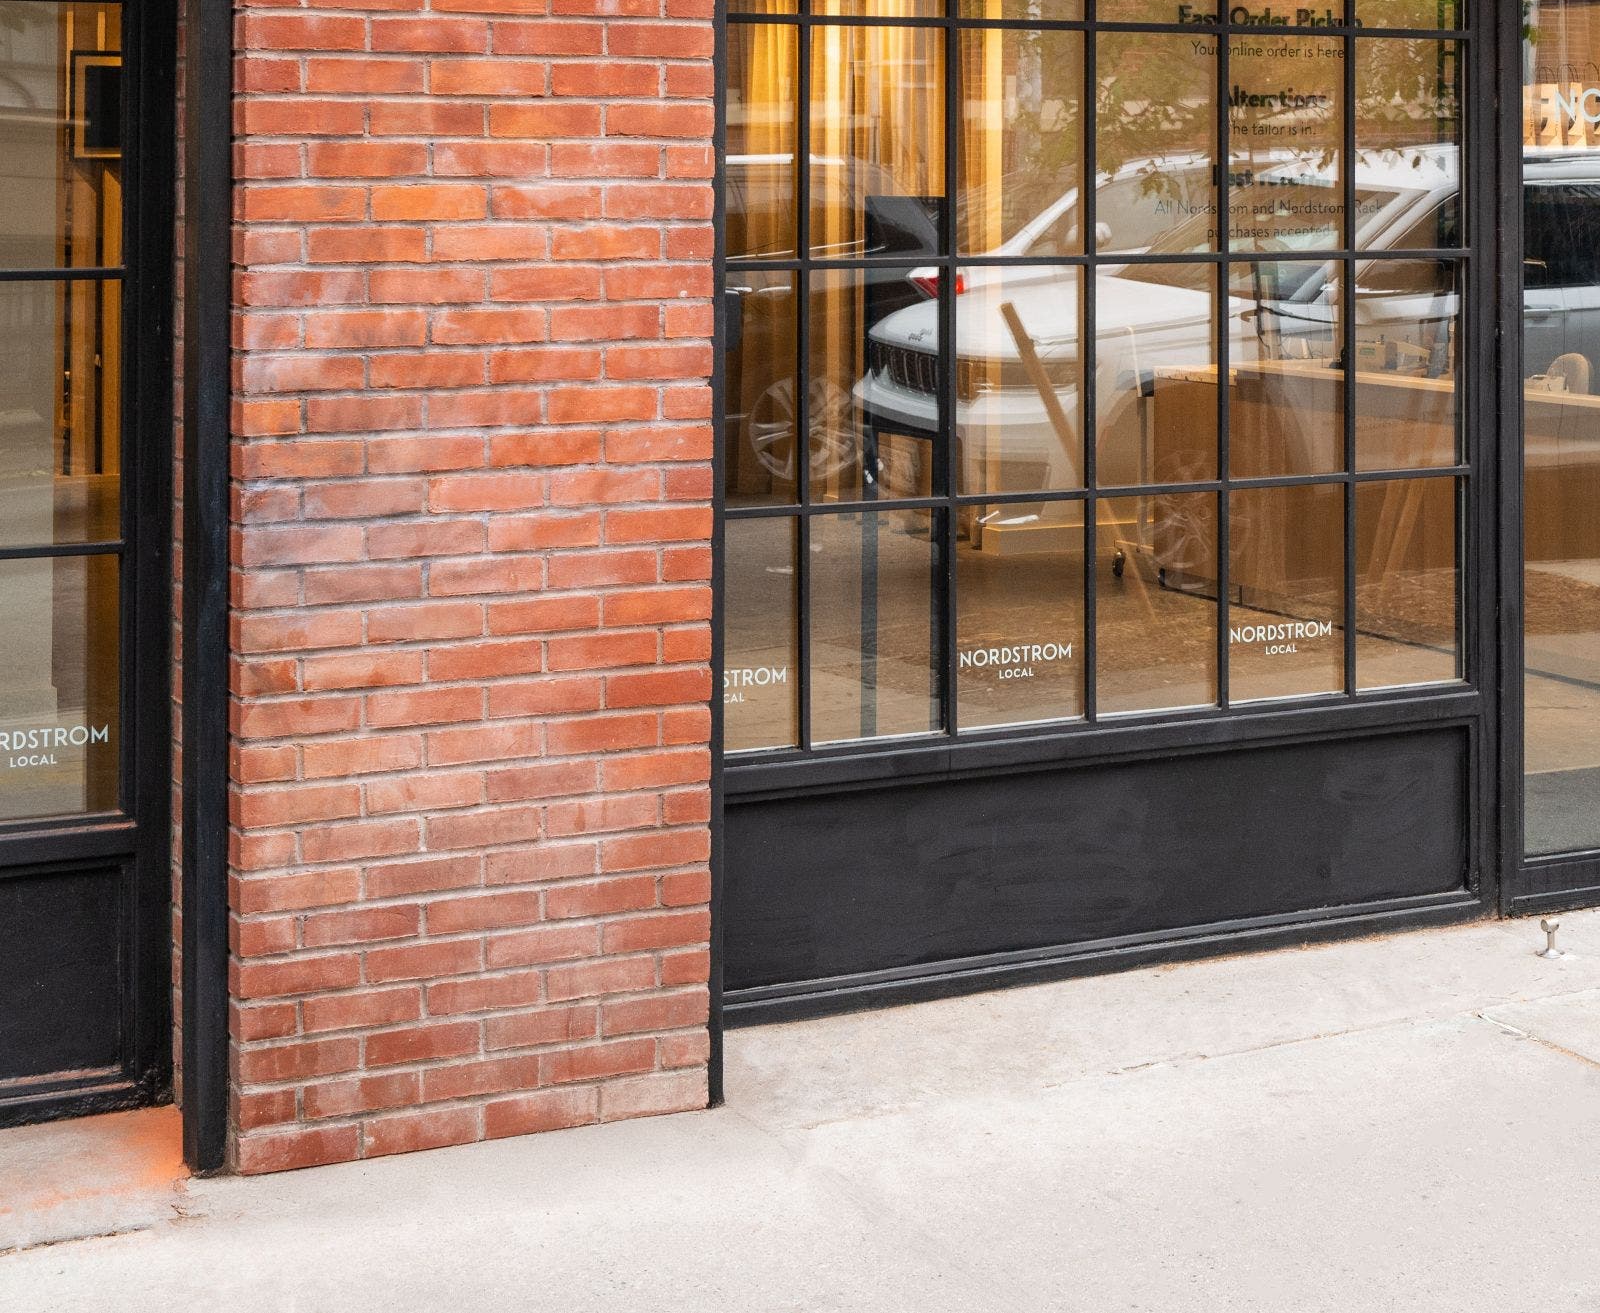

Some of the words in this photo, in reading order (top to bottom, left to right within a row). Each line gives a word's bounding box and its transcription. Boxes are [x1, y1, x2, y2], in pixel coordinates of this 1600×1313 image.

[1191, 40, 1220, 56] You
[1228, 42, 1263, 57] nline
[1267, 43, 1300, 58] order
[1304, 43, 1314, 58] is
[1252, 121, 1284, 136] tailor
[1288, 122, 1298, 136] is
[1177, 199, 1248, 215] Nordsom
[1251, 199, 1275, 215] and
[1207, 223, 1270, 244] pchases
[1229, 620, 1332, 644] NORDSTROM
[959, 642, 1072, 668] NORDSTROM
[1265, 644, 1298, 655] LOCAL
[724, 666, 787, 688] STROM
[999, 667, 1035, 679] LOCAL
[724, 692, 745, 704] CAL
[0, 723, 109, 751] RDSTROM
[9, 753, 58, 768] LOCAL
